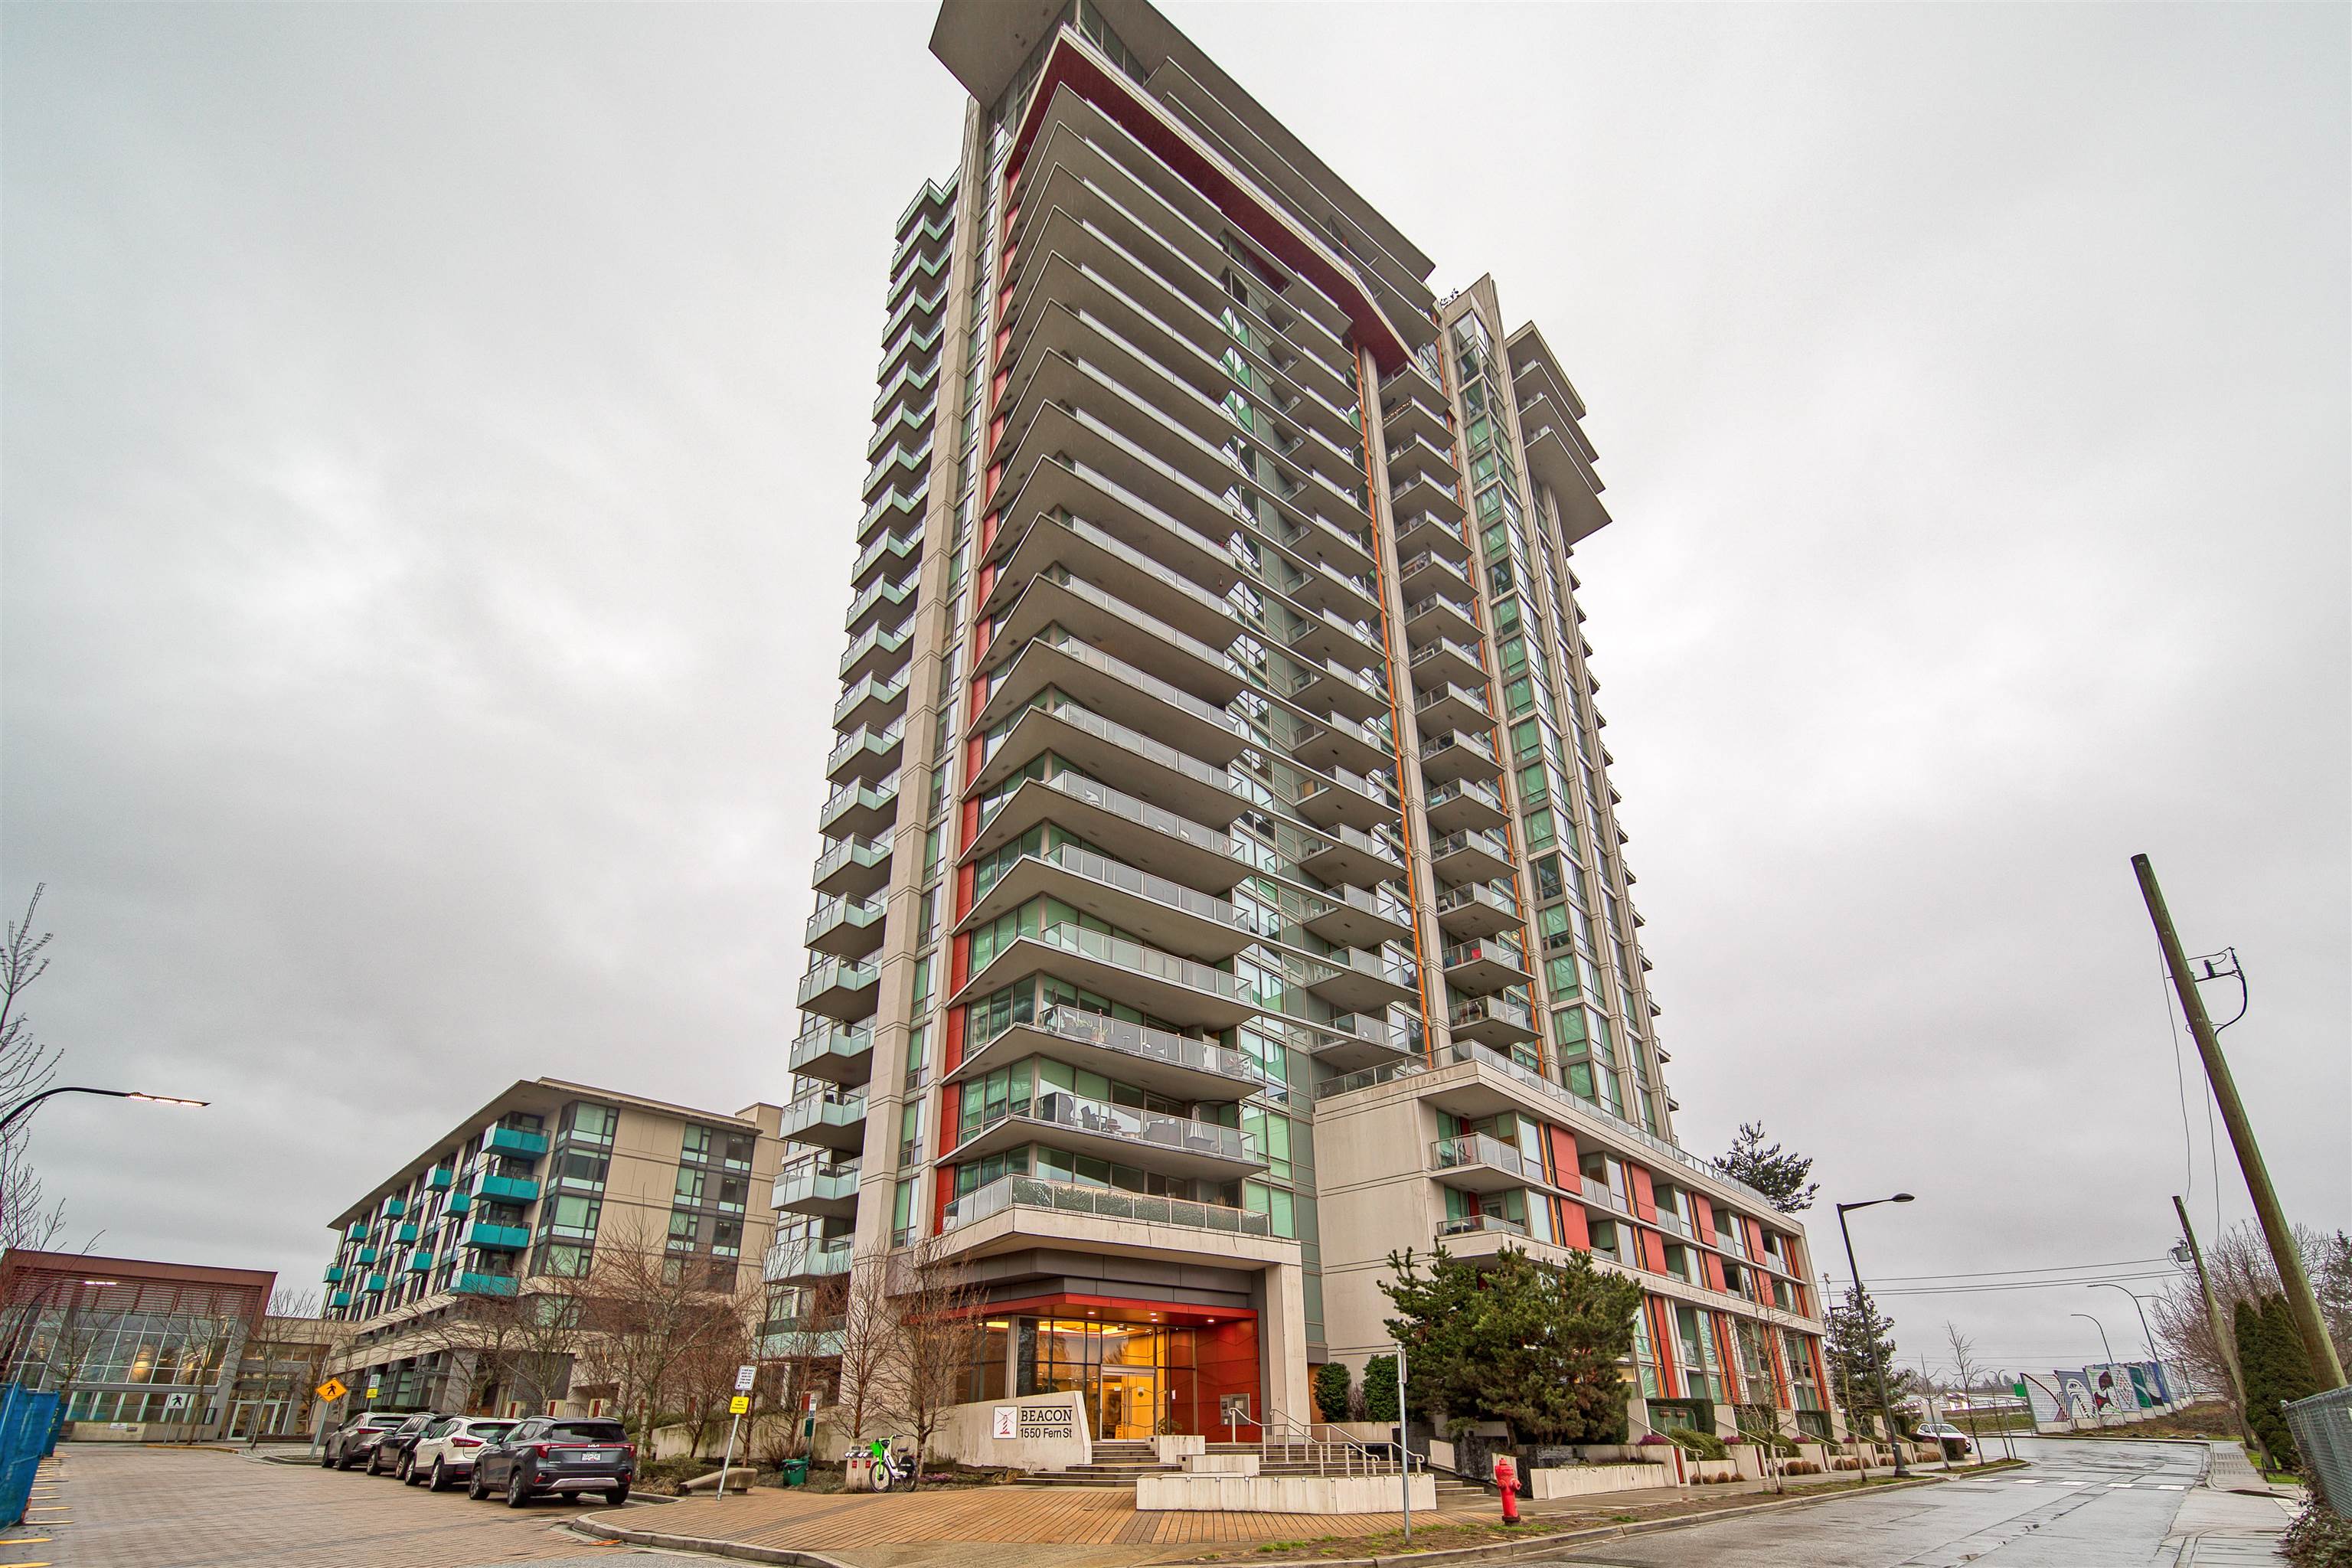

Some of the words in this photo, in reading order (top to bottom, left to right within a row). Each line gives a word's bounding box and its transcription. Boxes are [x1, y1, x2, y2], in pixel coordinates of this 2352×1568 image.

[1021, 1410, 1072, 1422] BEACON
[1020, 1428, 1040, 1438] 1550
[1044, 1428, 1061, 1438] Fern
[1063, 1428, 1072, 1438] St
